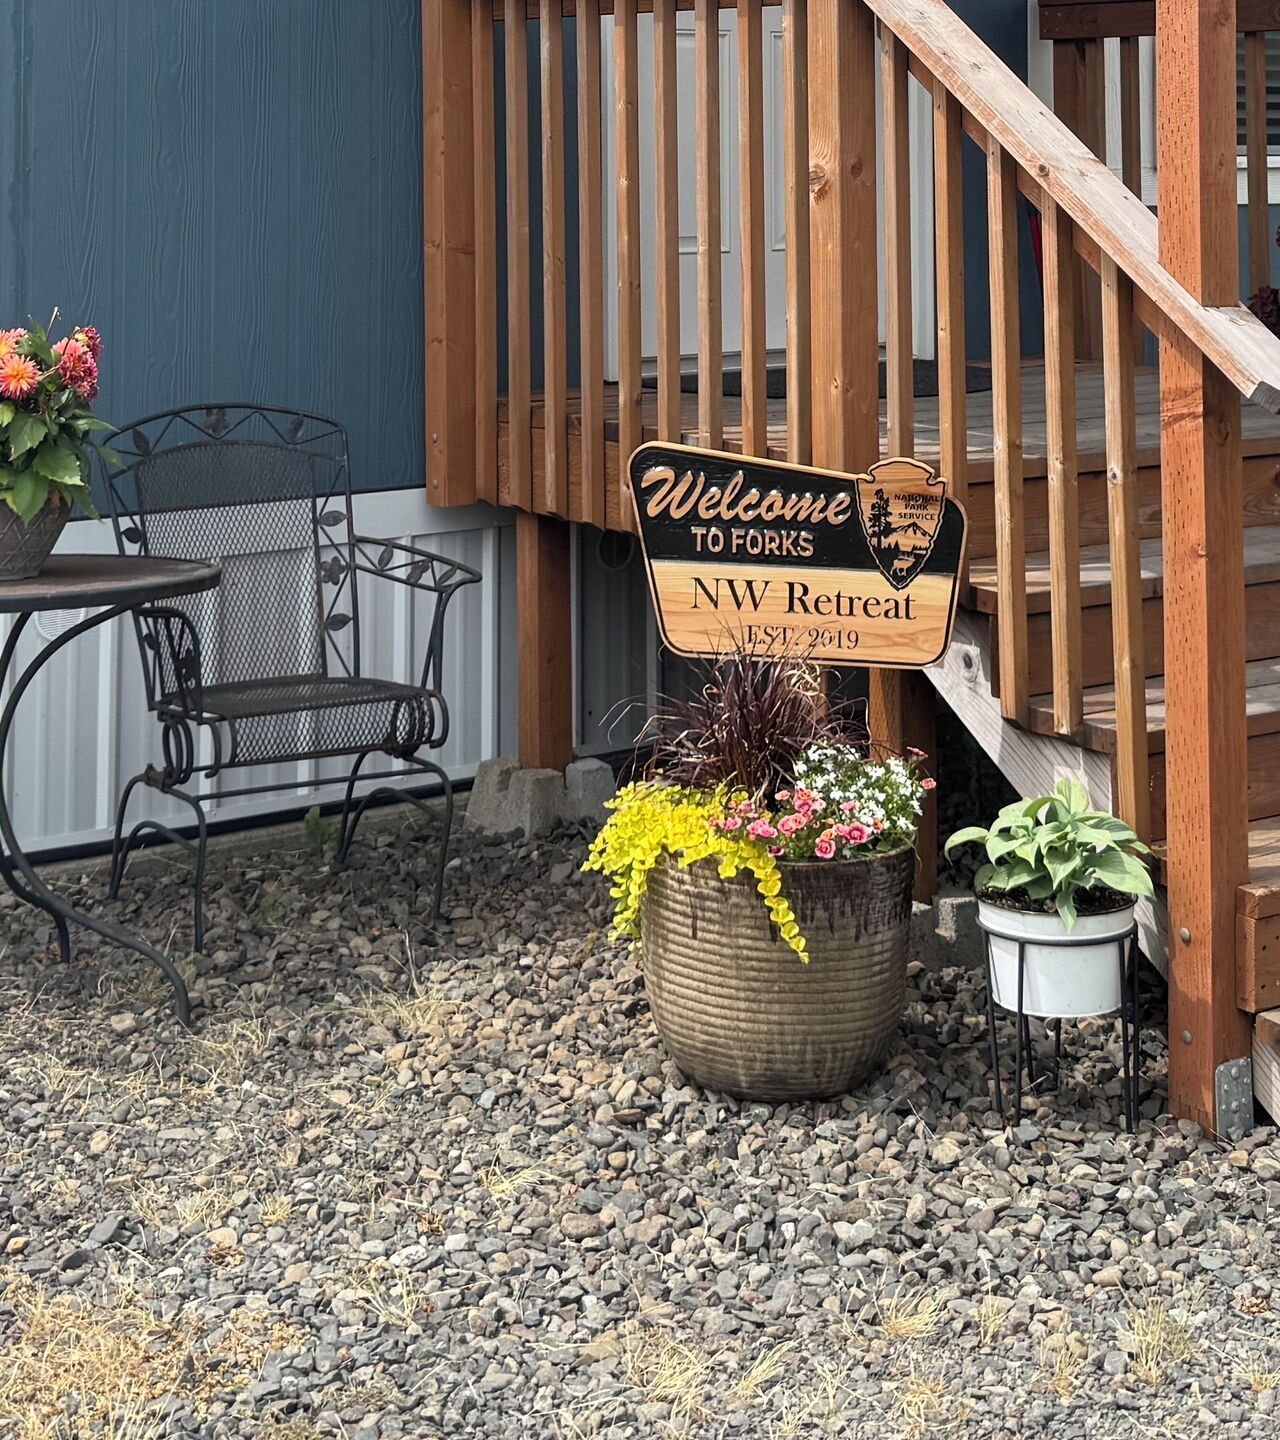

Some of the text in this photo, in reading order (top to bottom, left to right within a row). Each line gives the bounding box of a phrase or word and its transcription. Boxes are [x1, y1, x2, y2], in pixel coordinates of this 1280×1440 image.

[640, 466, 853, 526] Welcome
[904, 503, 929, 511] PARK
[898, 512, 936, 521] SERVICE
[691, 526, 815, 557] TO FORKS
[690, 577, 917, 621] NW Retreat
[746, 624, 859, 650] EST. 2019
